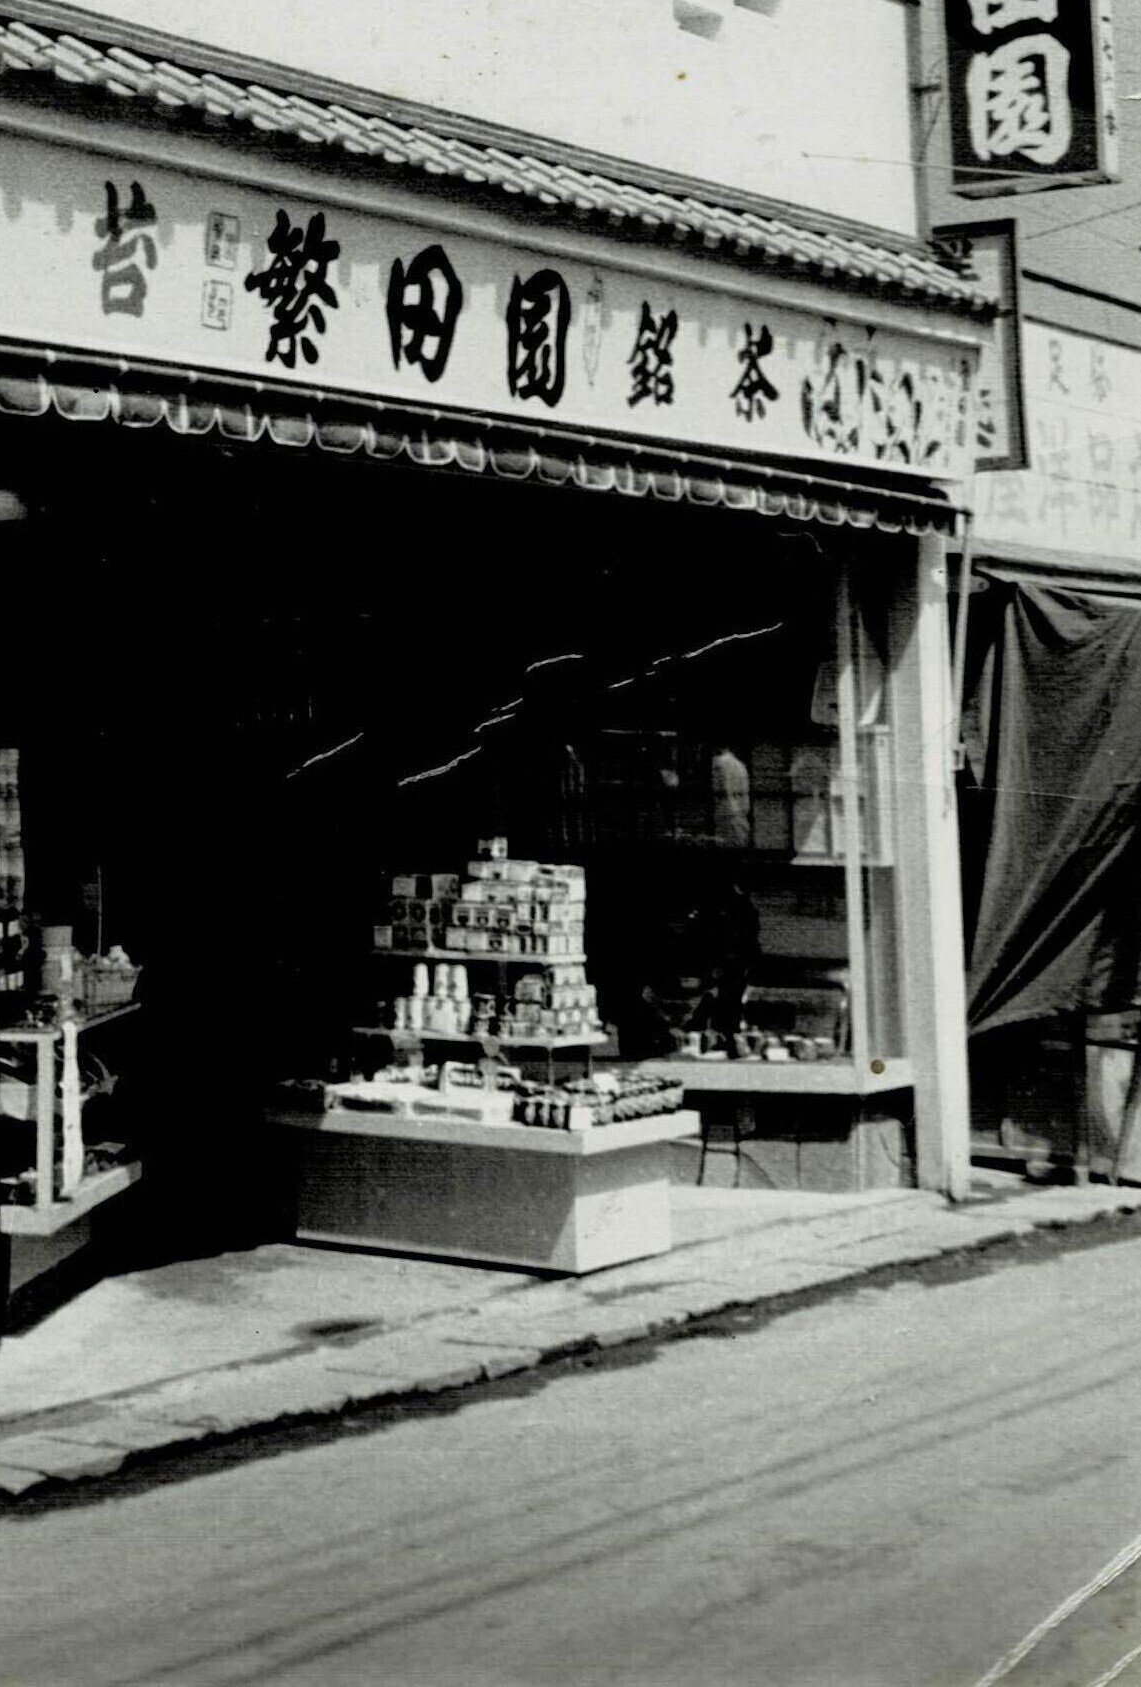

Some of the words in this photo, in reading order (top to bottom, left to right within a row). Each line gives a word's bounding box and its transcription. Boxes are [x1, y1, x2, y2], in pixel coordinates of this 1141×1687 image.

[244, 208, 571, 408] 繁田園
[628, 301, 780, 423] 銘茶
